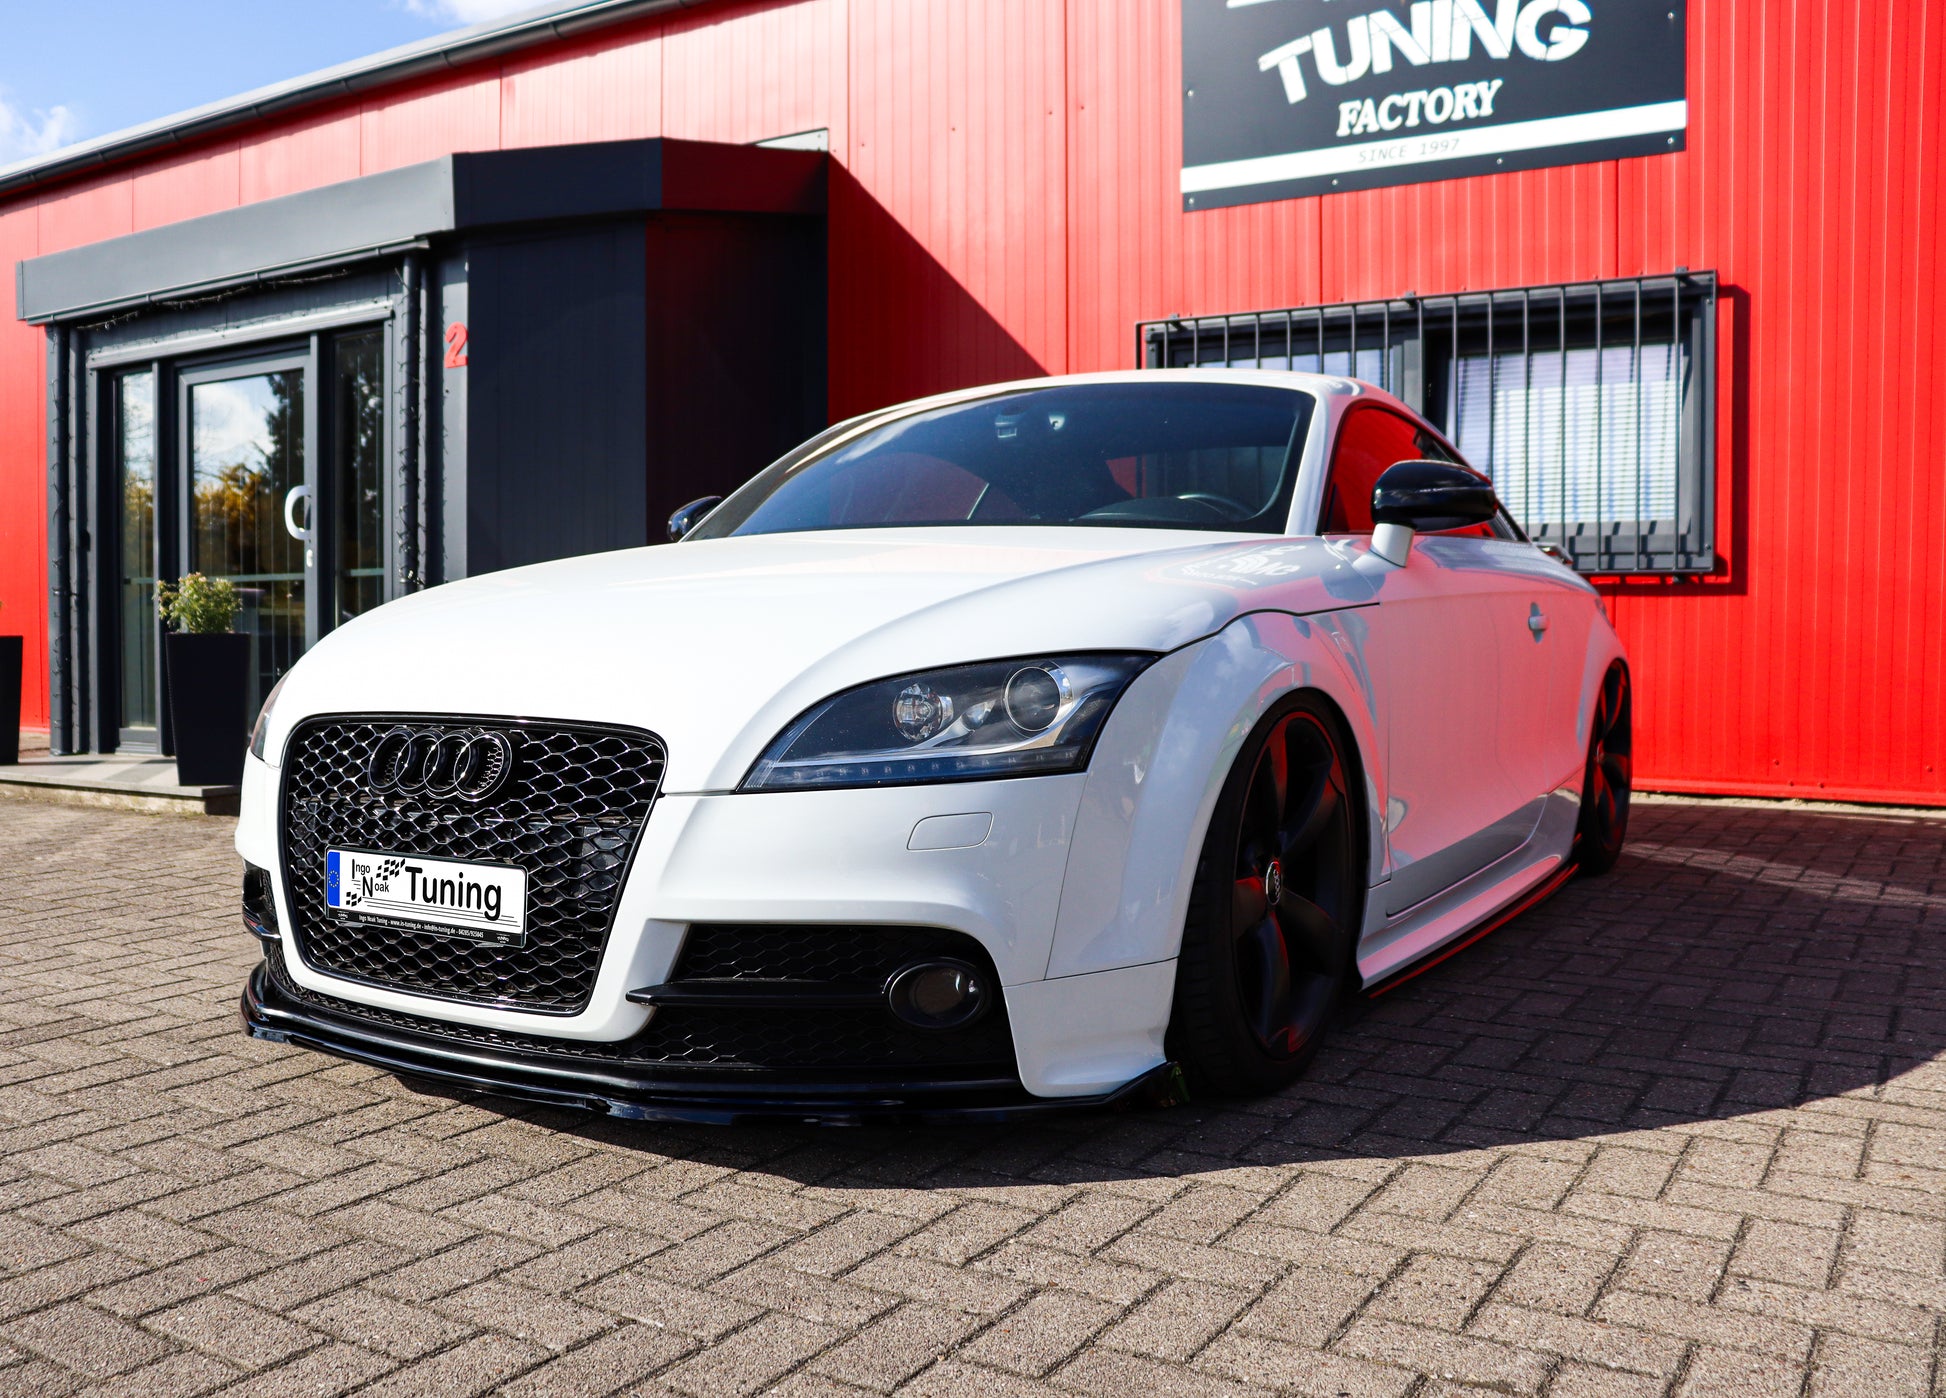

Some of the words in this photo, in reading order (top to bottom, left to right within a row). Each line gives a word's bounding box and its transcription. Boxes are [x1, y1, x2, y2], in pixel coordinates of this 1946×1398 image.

[1258, 0, 1593, 104] TUNING
[1336, 78, 1503, 137] FACTORY
[1359, 144, 1407, 163] SINCE
[1419, 138, 1460, 156] 1997
[443, 321, 469, 368] 2
[351, 858, 371, 880] Ingo
[362, 876, 390, 898] Noak
[404, 865, 502, 921] Tuning
